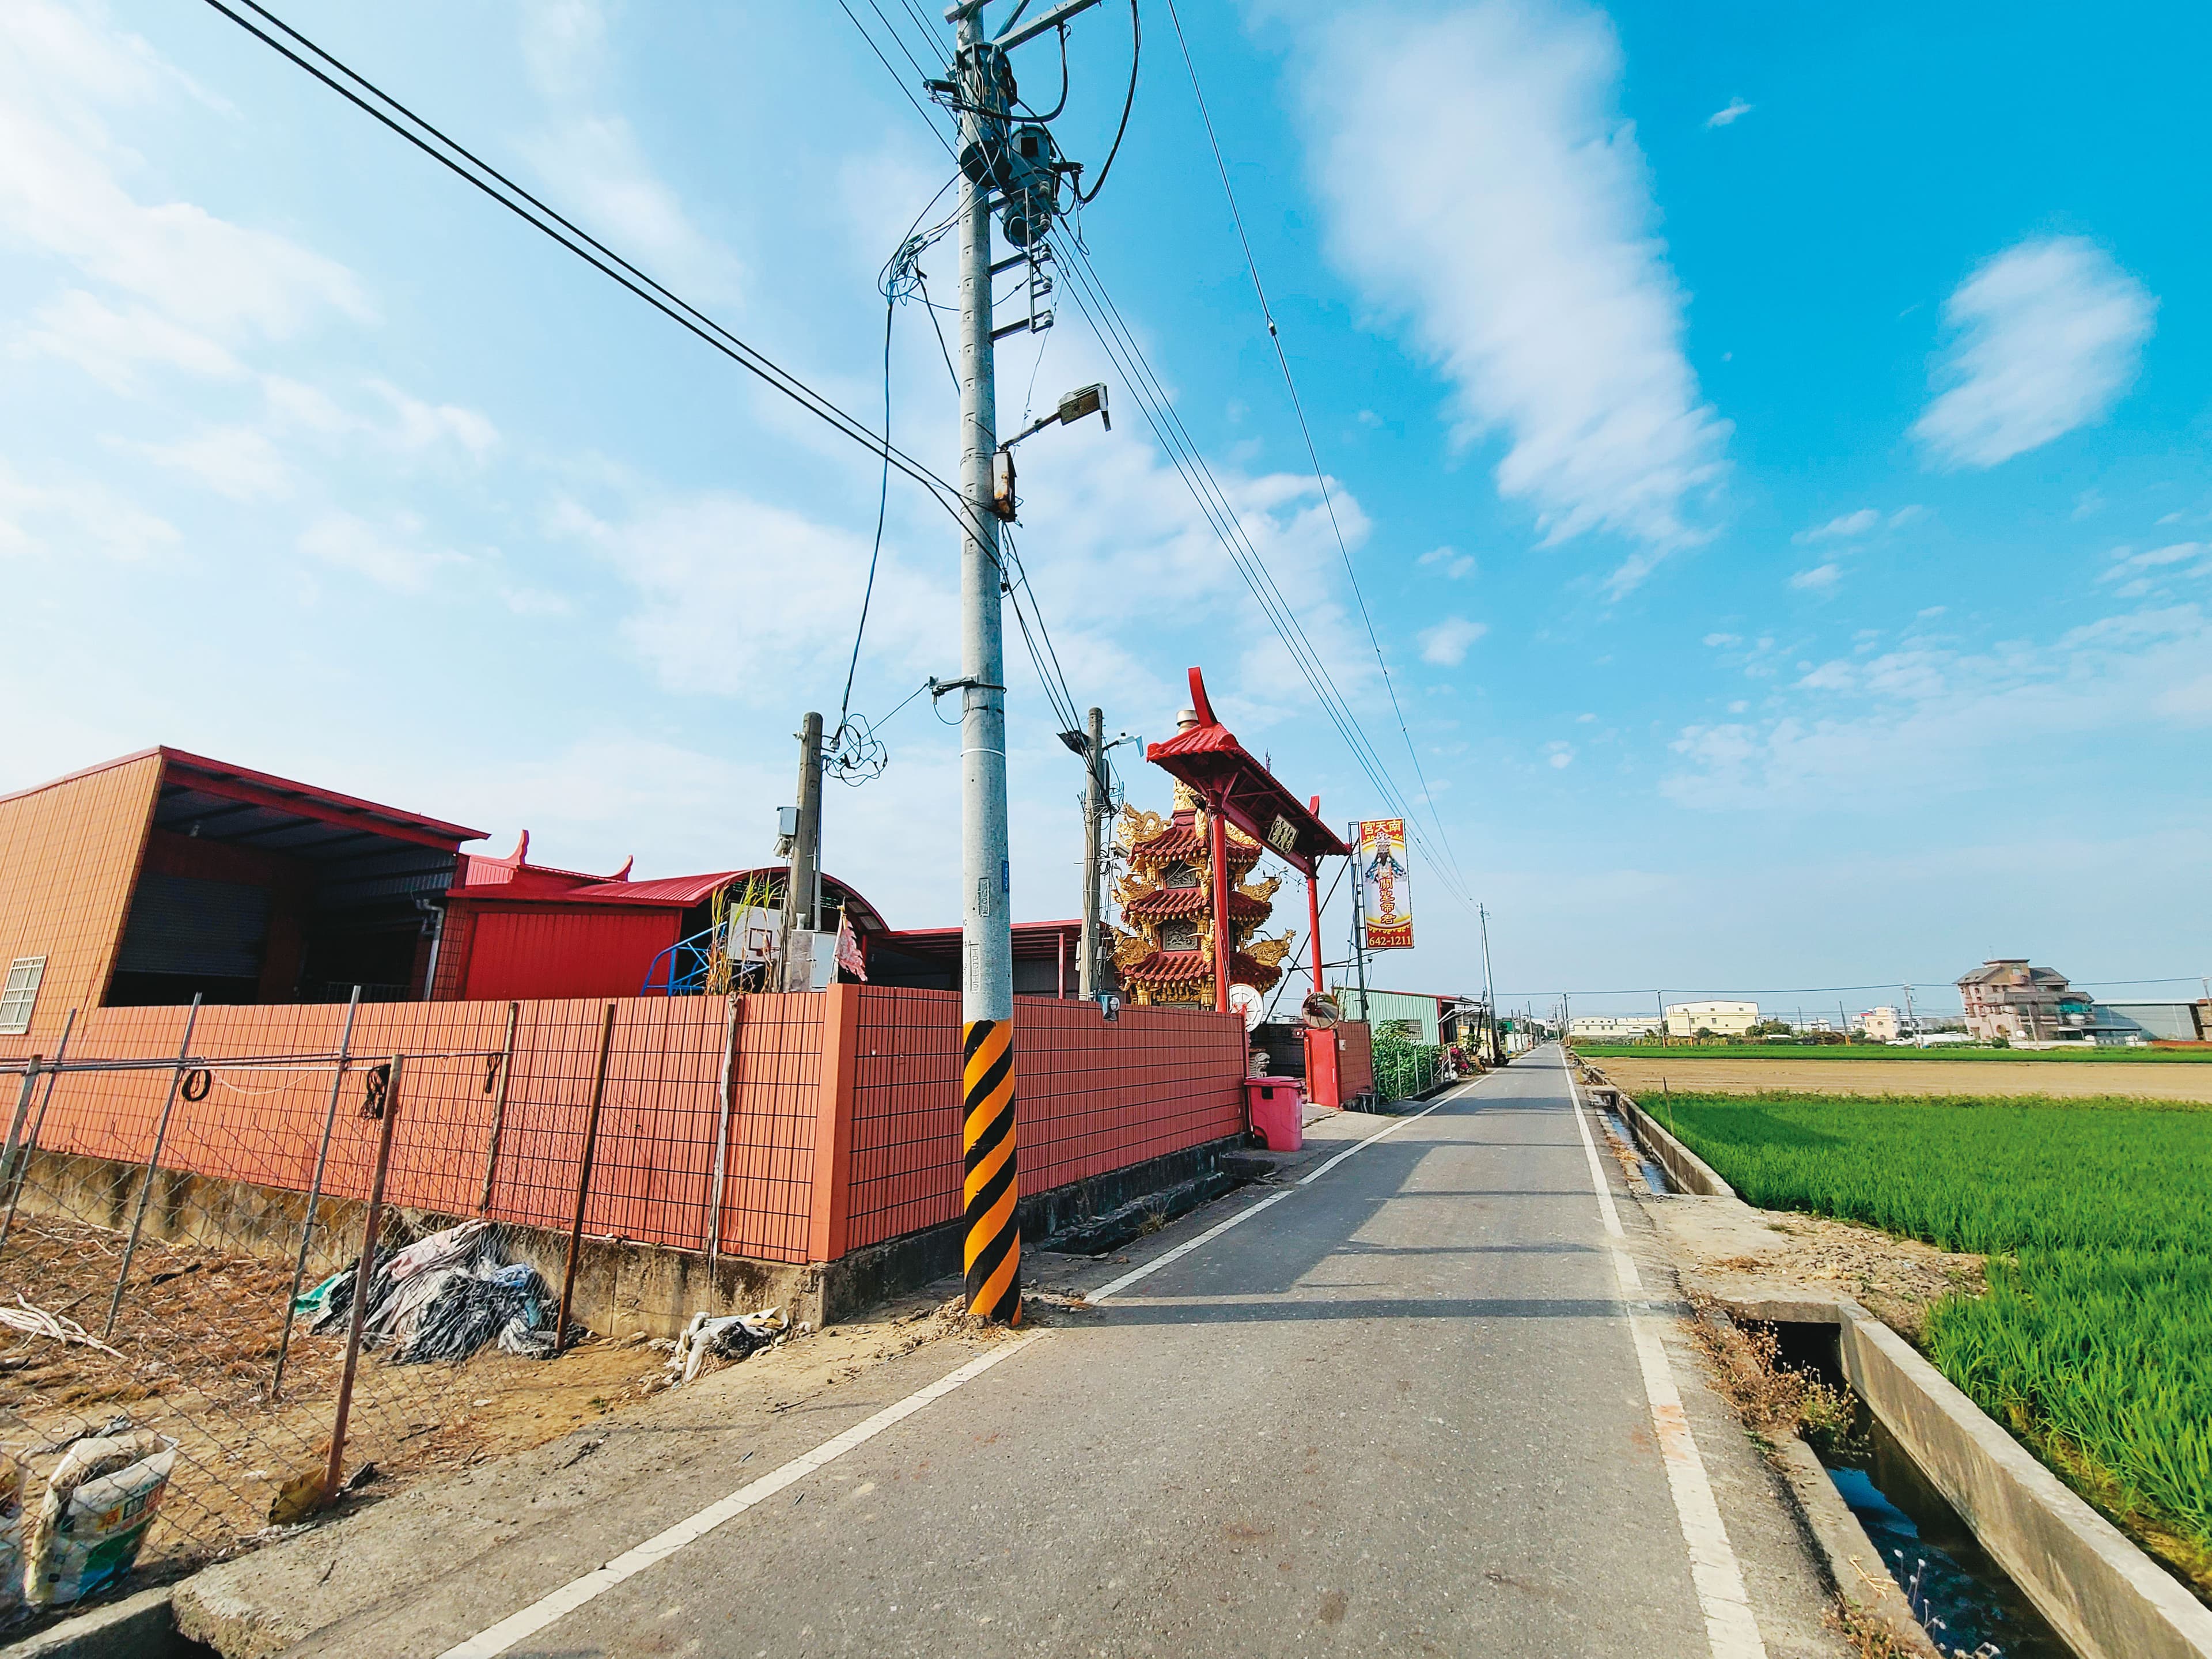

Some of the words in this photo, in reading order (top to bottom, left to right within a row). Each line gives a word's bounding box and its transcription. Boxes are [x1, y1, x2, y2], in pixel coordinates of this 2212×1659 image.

[1379, 878, 1396, 925] 關聖帝君
[1369, 935, 1411, 946] 642-1211
